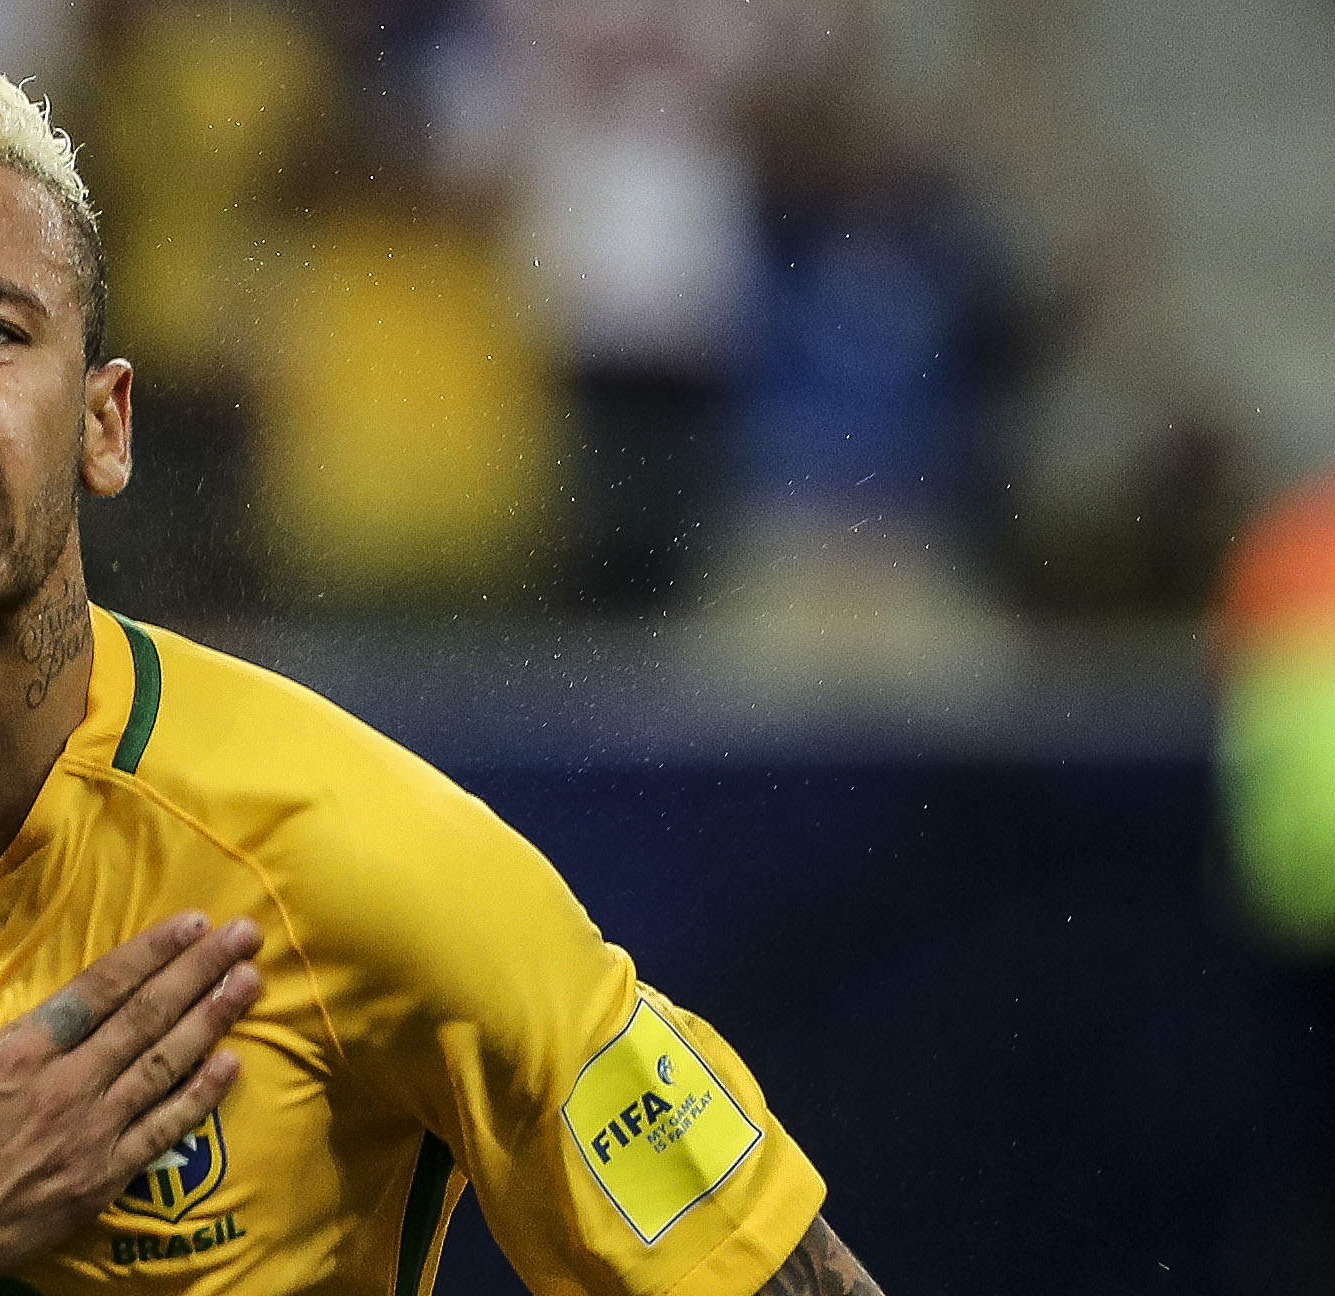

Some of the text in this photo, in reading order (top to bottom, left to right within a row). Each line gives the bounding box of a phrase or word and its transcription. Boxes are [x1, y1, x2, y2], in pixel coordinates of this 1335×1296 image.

[591, 1089, 674, 1165] FIFA
[647, 1092, 697, 1144] MY GAME
[668, 1117, 693, 1144] FAIR
[687, 1089, 713, 1118] PLAY
[112, 1213, 247, 1267] BRASIL
